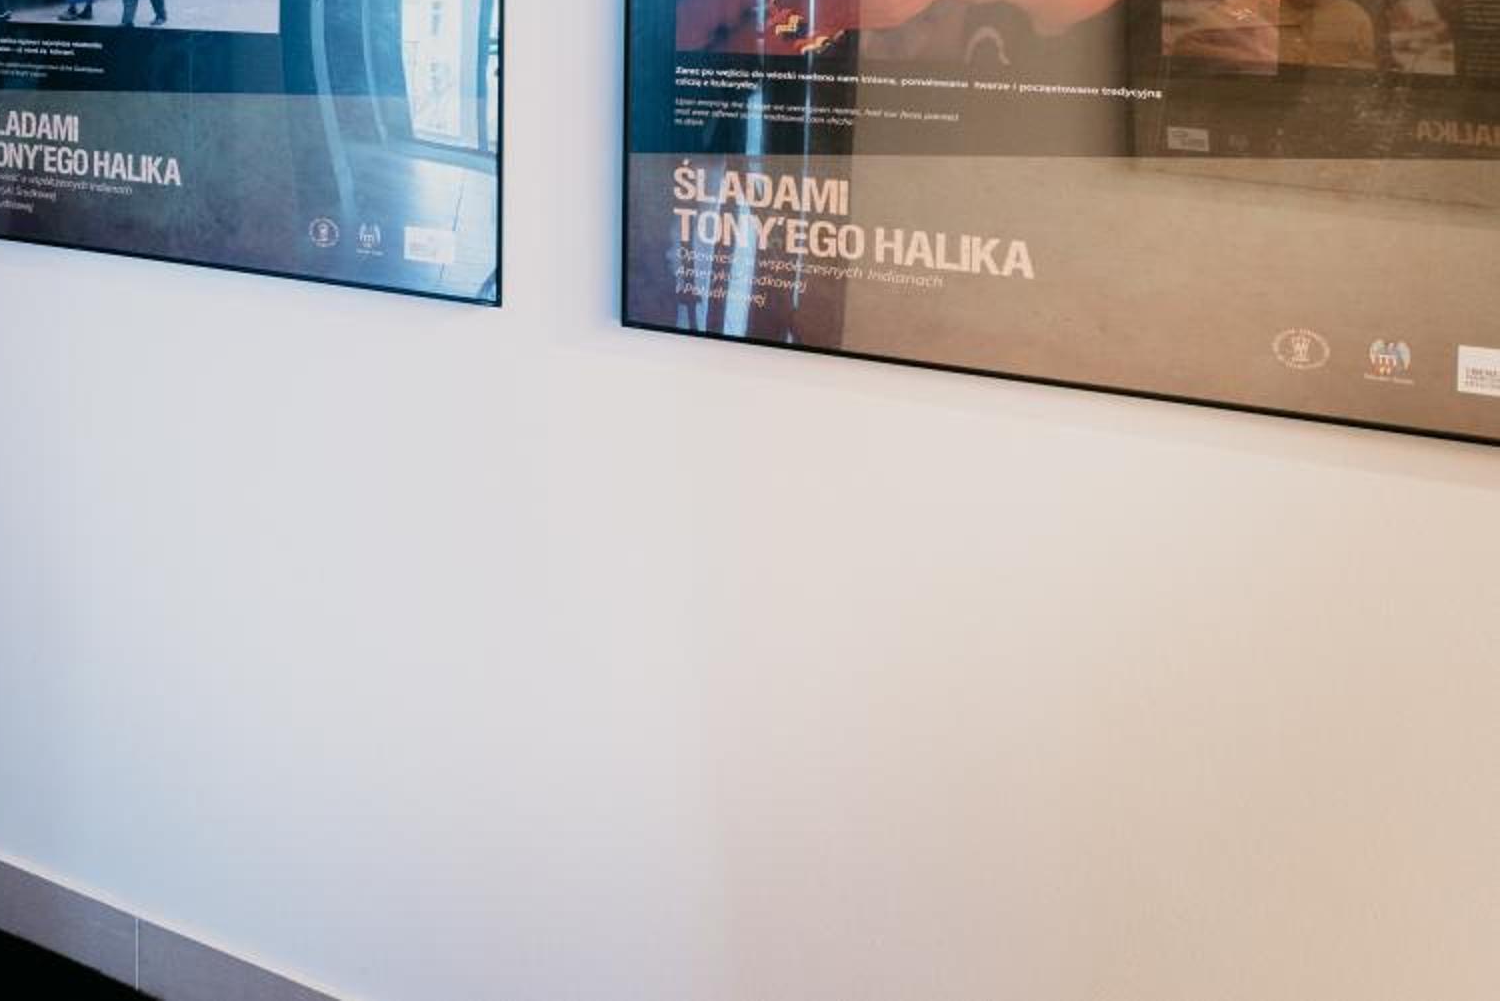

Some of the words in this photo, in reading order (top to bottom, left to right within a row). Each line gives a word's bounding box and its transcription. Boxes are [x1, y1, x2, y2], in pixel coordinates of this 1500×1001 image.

[92, 151, 182, 187] HALIKA
[673, 159, 850, 217] ŚLADAMI
[874, 226, 1036, 280] HALIKA
